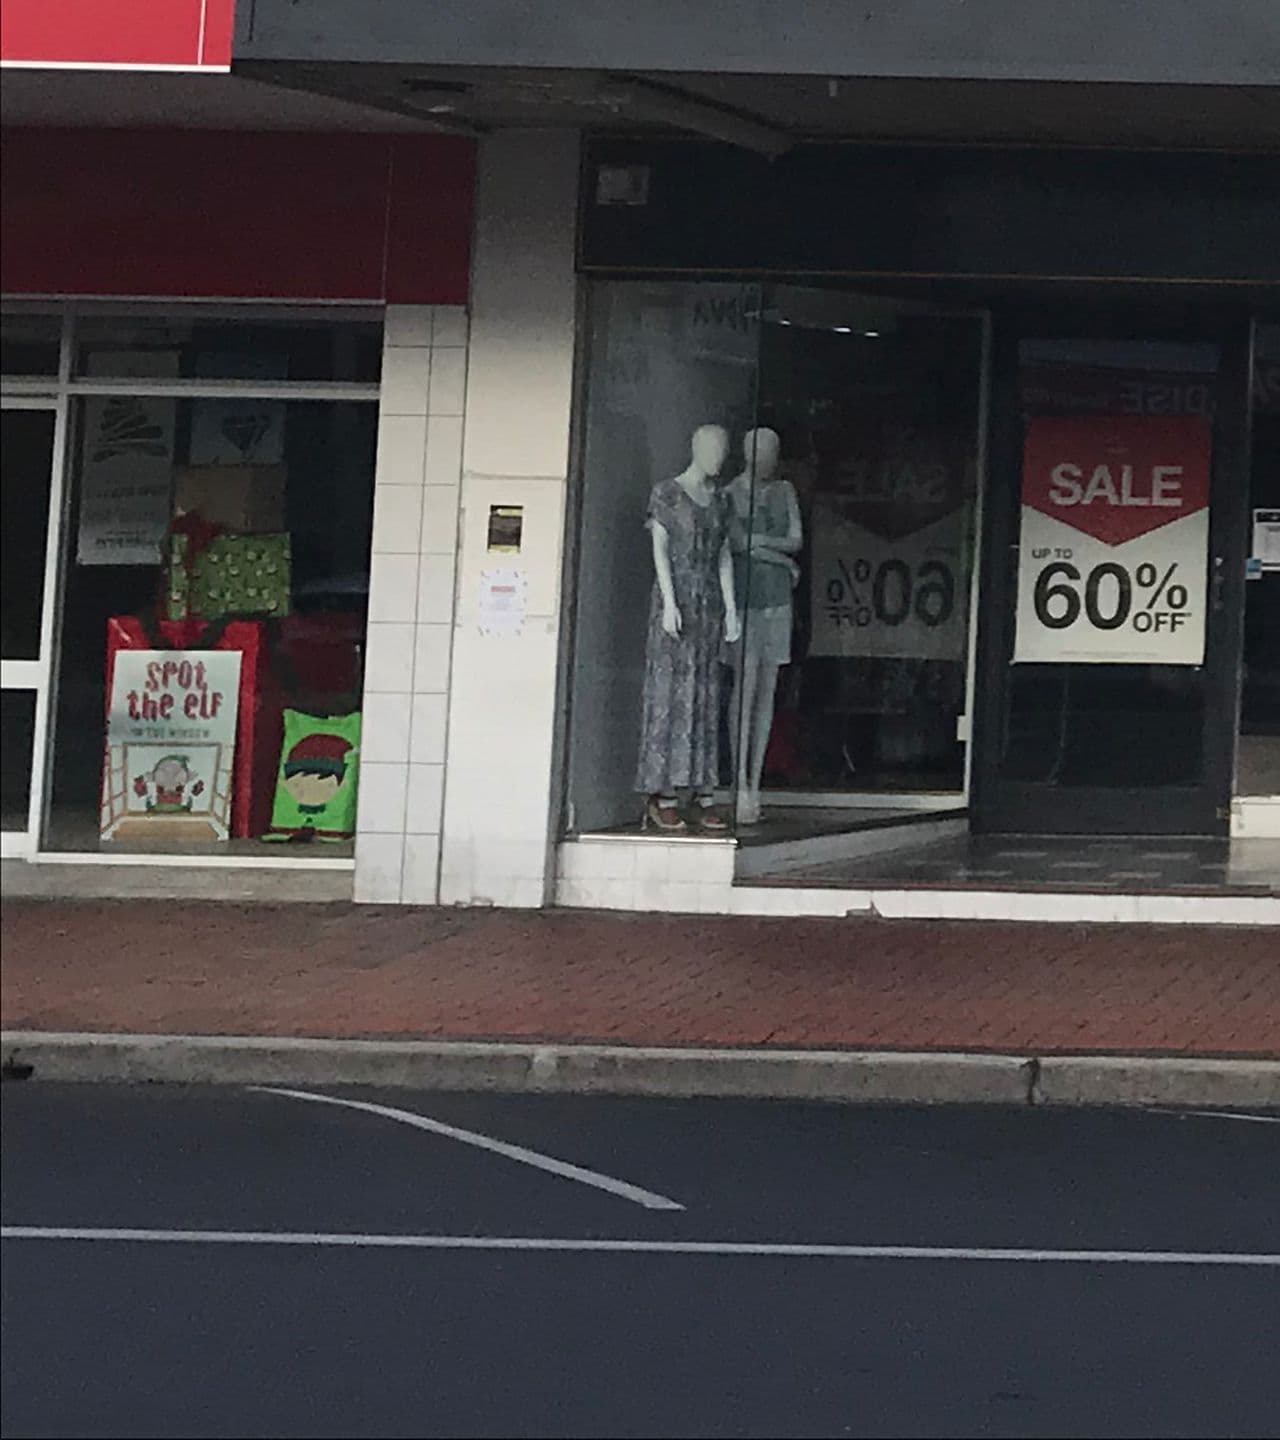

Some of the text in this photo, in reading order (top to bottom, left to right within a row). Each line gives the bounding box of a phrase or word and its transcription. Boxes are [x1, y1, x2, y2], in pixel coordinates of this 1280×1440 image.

[1049, 463, 1183, 507] SALE
[1032, 548, 1073, 559] UP TO
[1034, 562, 1188, 630] 60%
